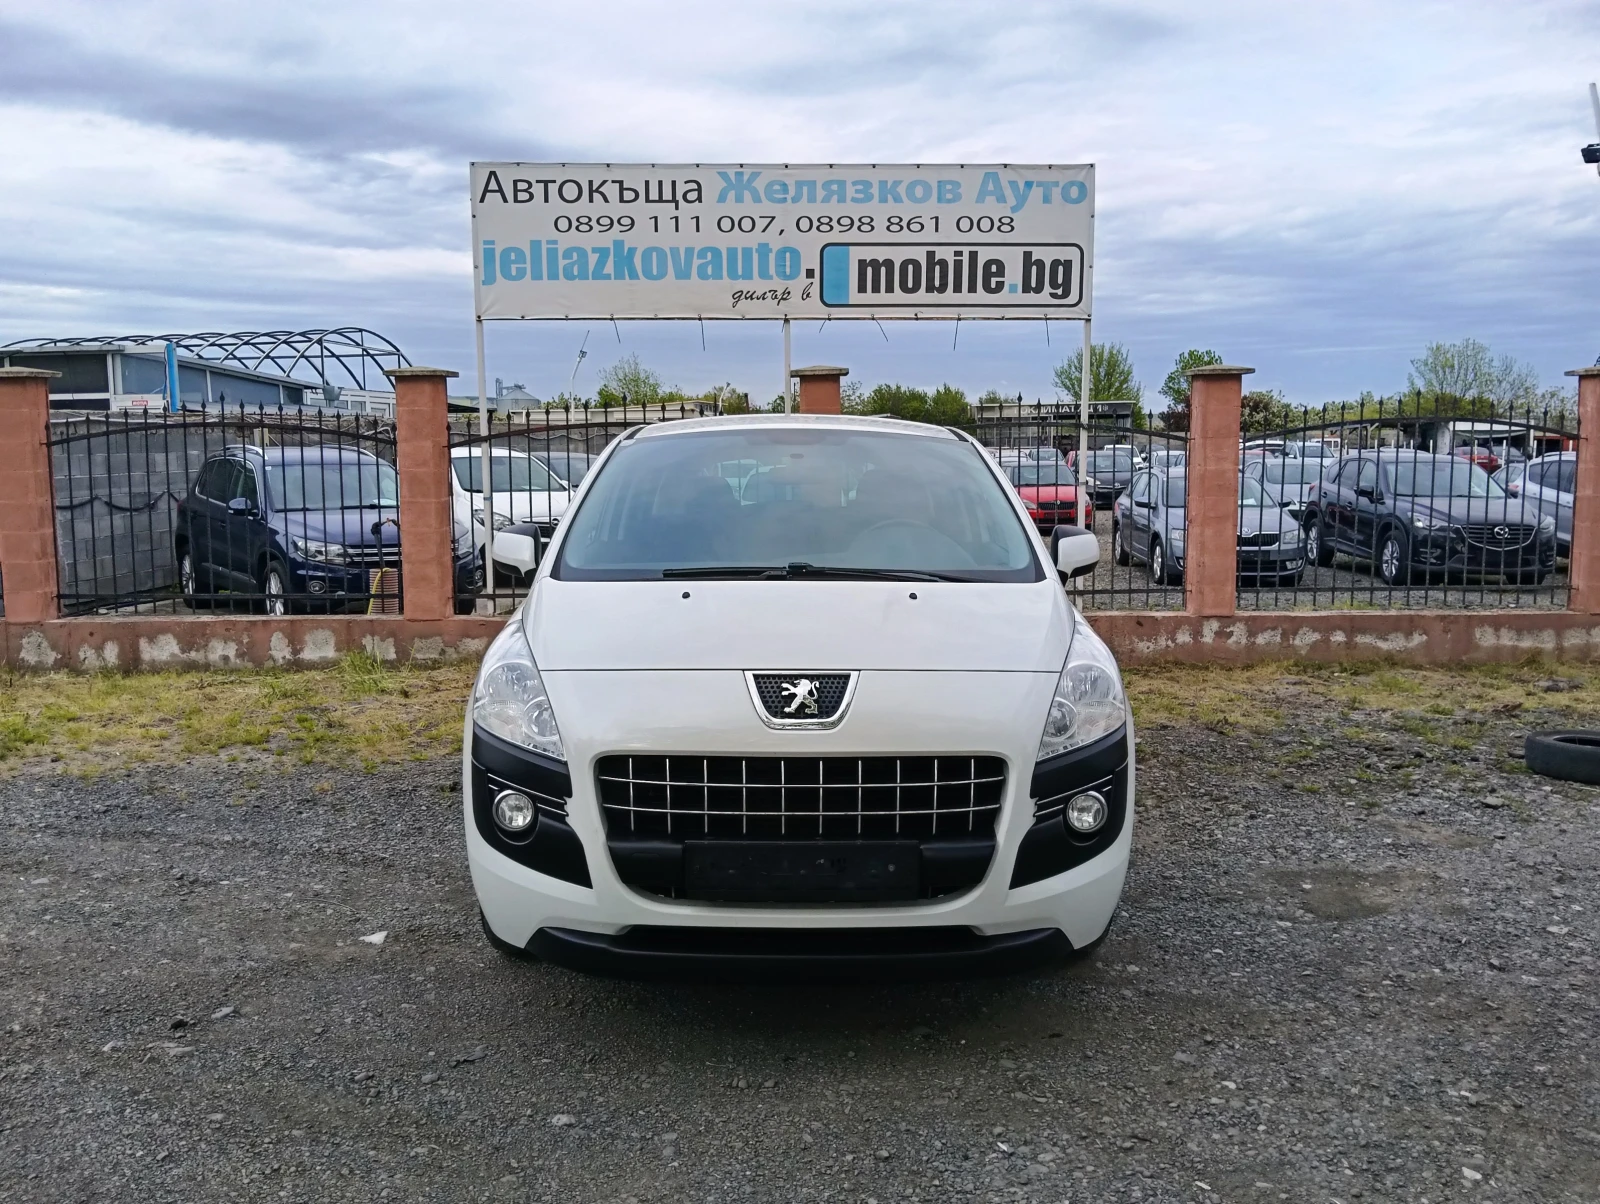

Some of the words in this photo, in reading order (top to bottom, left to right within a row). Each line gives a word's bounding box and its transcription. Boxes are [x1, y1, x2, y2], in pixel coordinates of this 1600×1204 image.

[479, 170, 703, 211] Автокъща
[716, 171, 963, 205] Желязков
[975, 171, 1088, 214] Ауто
[554, 215, 636, 233] 0899
[649, 215, 700, 233] 111
[717, 215, 786, 236] 007,
[796, 215, 875, 233] 0898
[886, 215, 940, 233] 861
[956, 215, 1015, 233] 008
[857, 250, 1073, 300] mobile.bg
[732, 287, 792, 309] дилър
[801, 281, 814, 301] в
